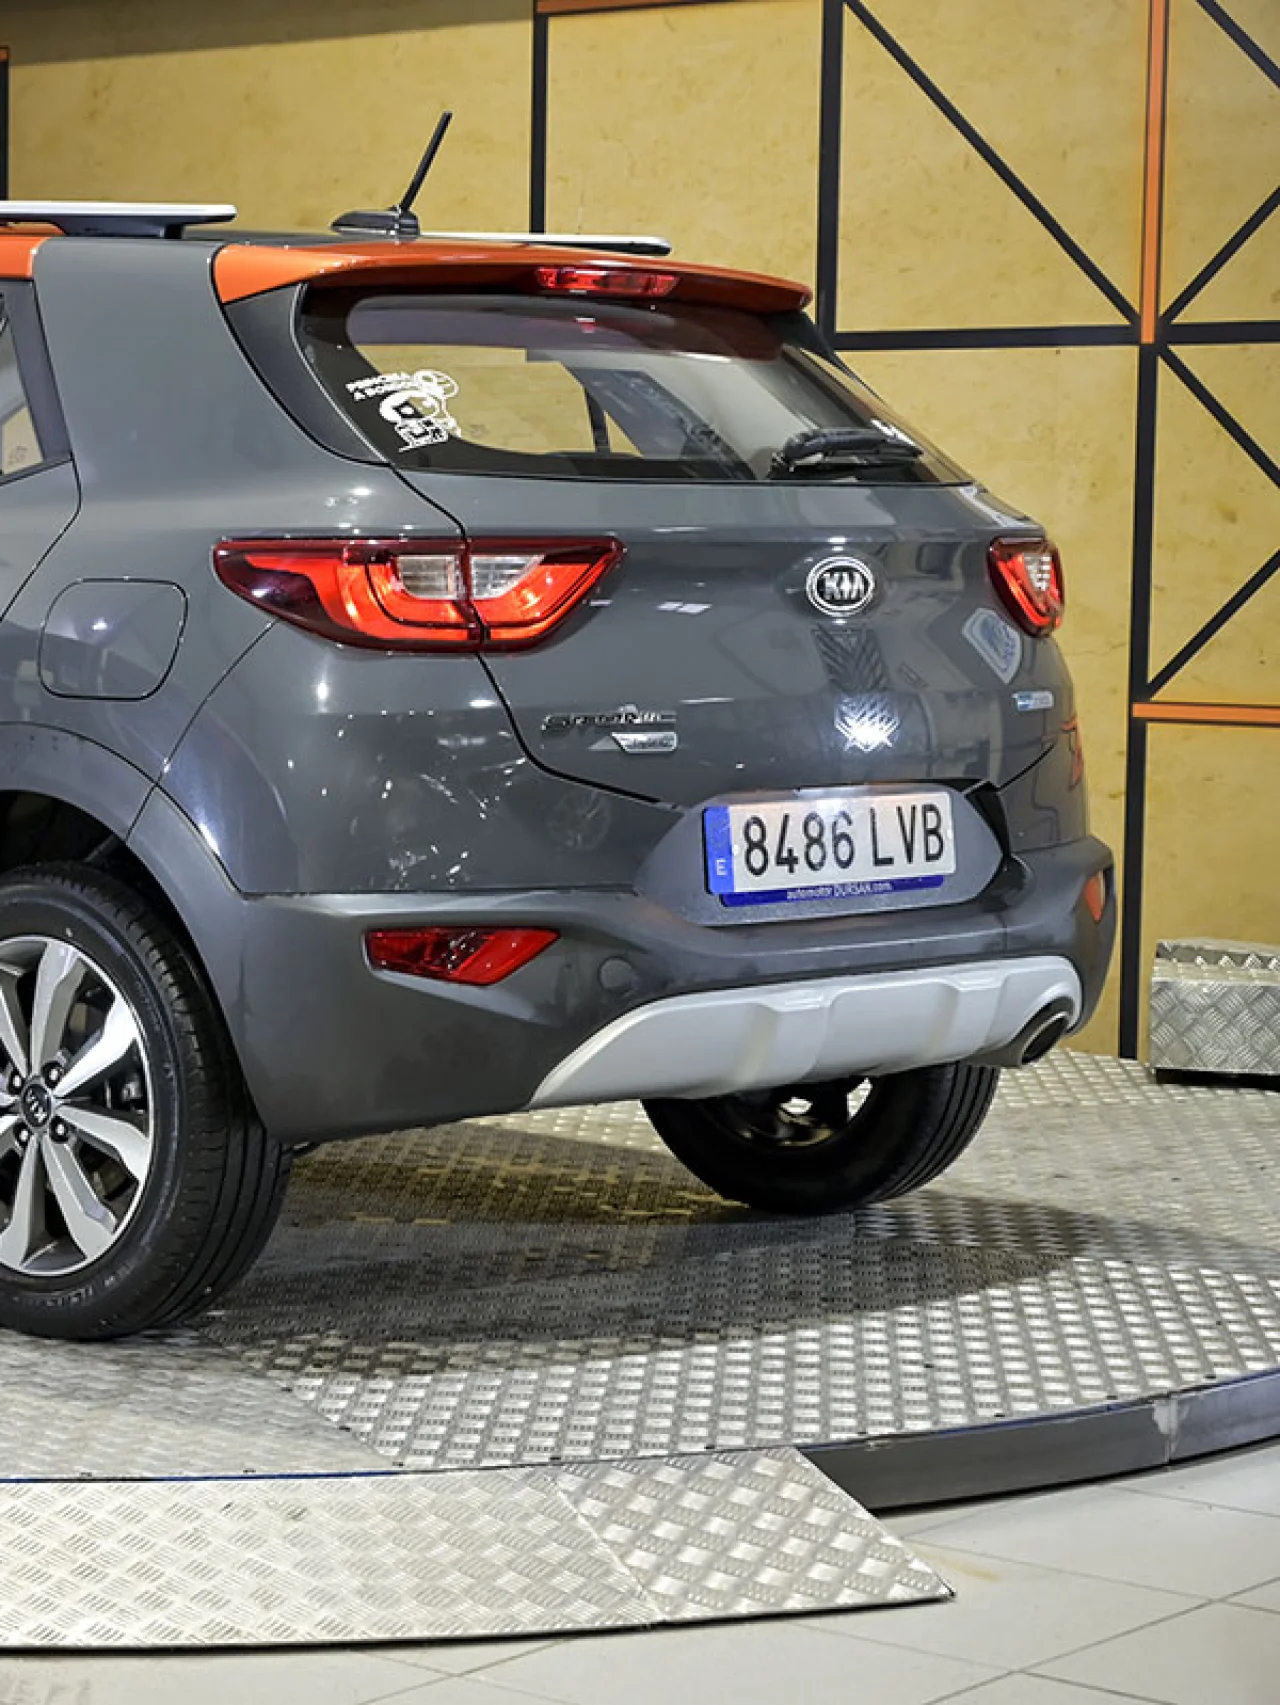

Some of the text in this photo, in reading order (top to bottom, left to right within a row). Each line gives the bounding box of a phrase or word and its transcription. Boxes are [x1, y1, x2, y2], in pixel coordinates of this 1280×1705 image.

[823, 572, 865, 600] KIA
[743, 803, 944, 876] 8486 LVB
[716, 859, 728, 876] E
